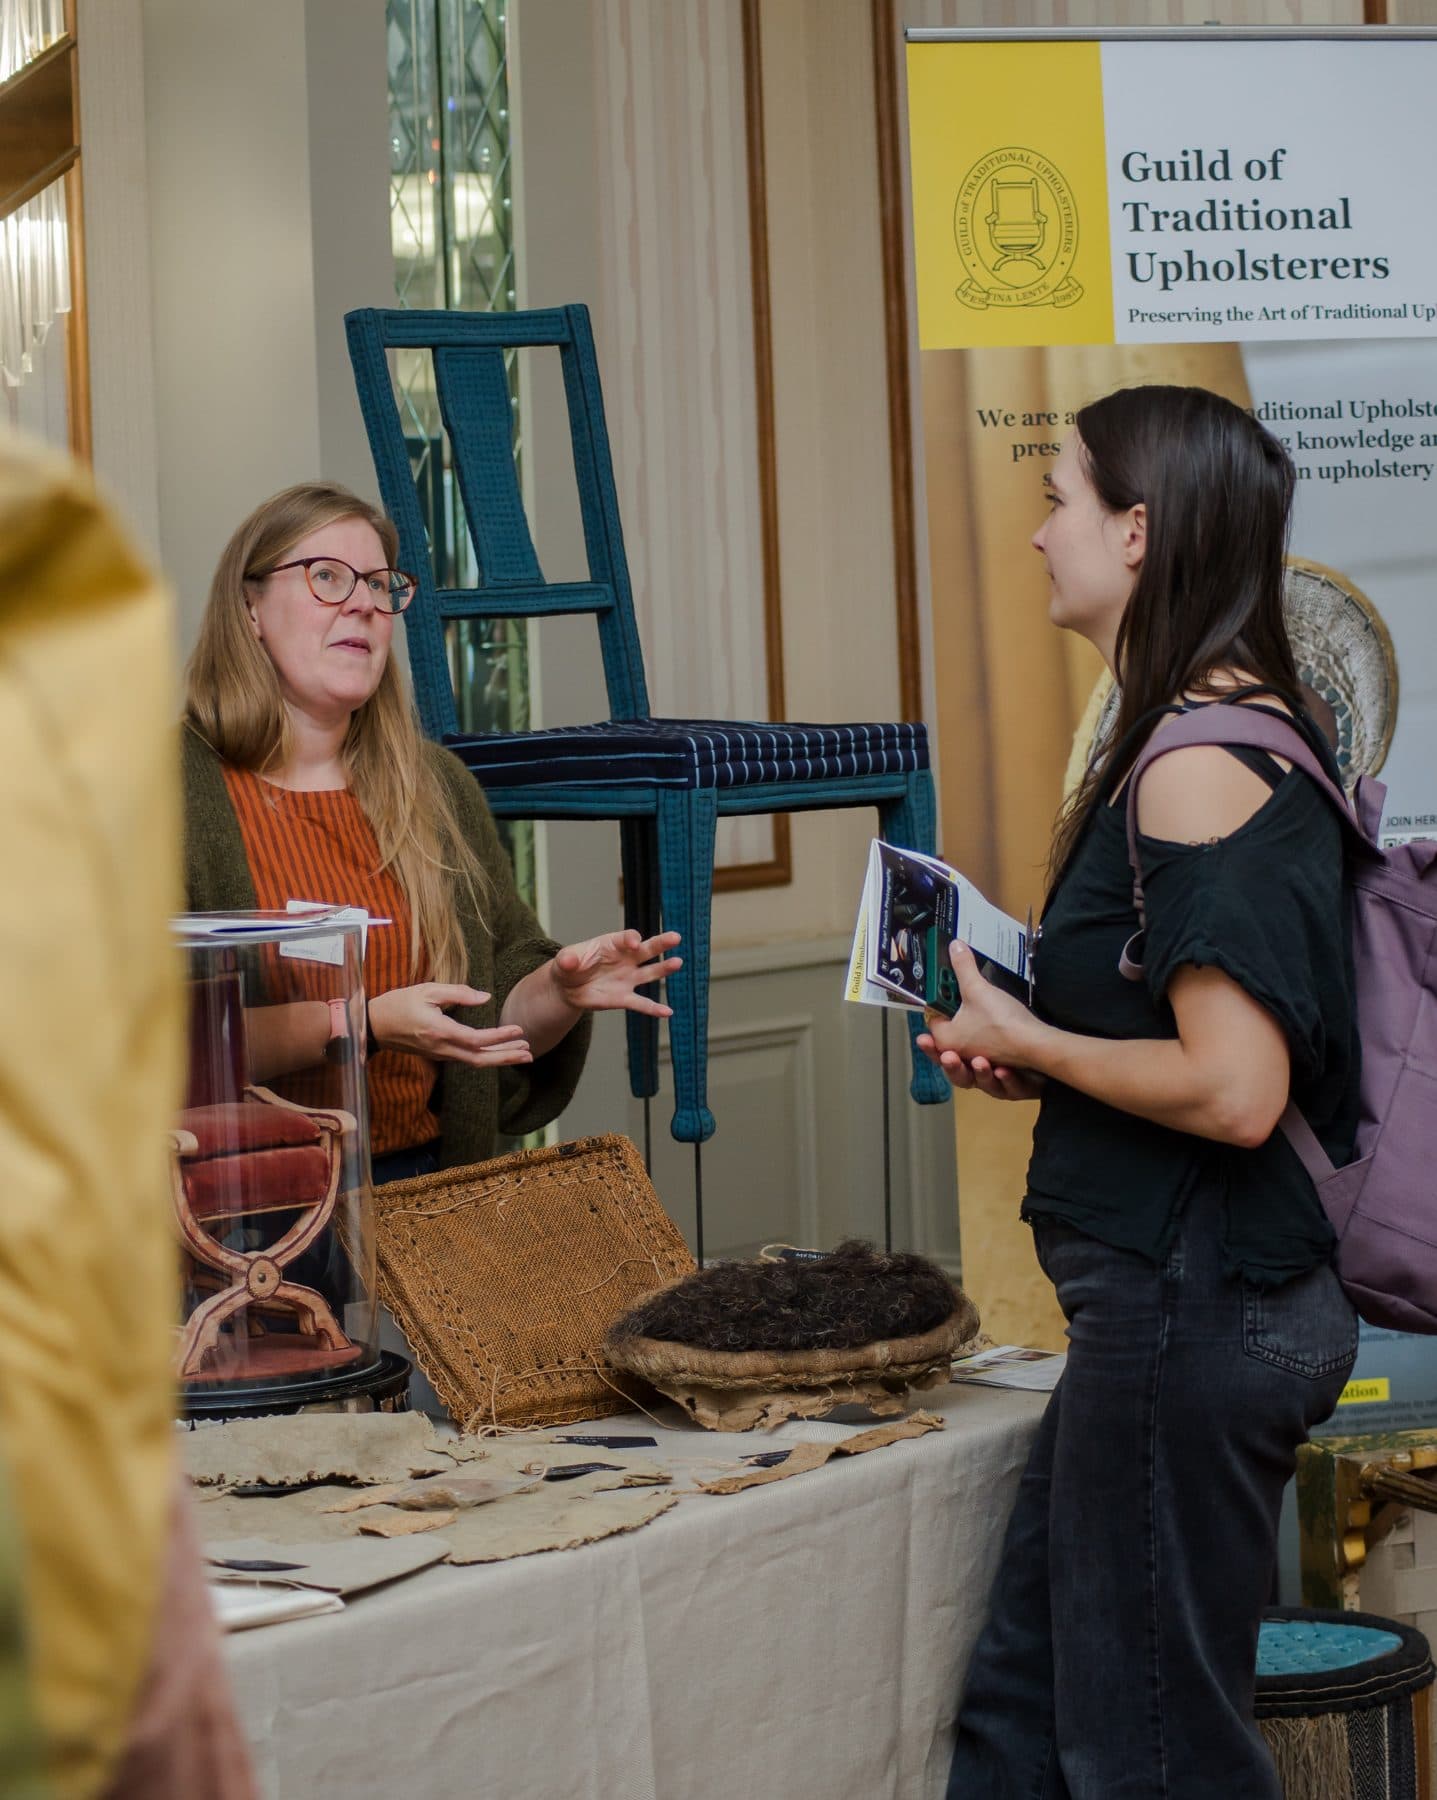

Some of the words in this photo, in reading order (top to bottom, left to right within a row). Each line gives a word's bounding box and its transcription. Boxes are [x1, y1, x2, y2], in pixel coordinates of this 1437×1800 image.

[963, 152, 1034, 198] TRADITIONAL
[1121, 149, 1231, 183] Guild
[1244, 148, 1287, 182] of
[960, 202, 970, 214] of
[1035, 161, 1075, 255] UPHOLSTERERS
[1123, 197, 1352, 234] Traditional
[959, 217, 973, 256] GUILD
[1127, 250, 1390, 291] Upholsterers
[1016, 282, 1050, 302] LENTE
[1128, 307, 1223, 325] Preserving
[1227, 306, 1255, 321] the
[1258, 306, 1287, 321] Art
[1291, 304, 1311, 321] of
[1313, 303, 1408, 320] Traditional
[1412, 303, 1437, 323] Up
[977, 409, 1016, 427] We
[1022, 412, 1059, 426] are
[1012, 442, 1061, 462] pres
[1297, 429, 1415, 453] knowledge
[1318, 459, 1434, 484] upholstery
[1386, 815, 1412, 828] JOIN
[1415, 814, 1437, 825] HER
[1342, 1385, 1379, 1400] ation
